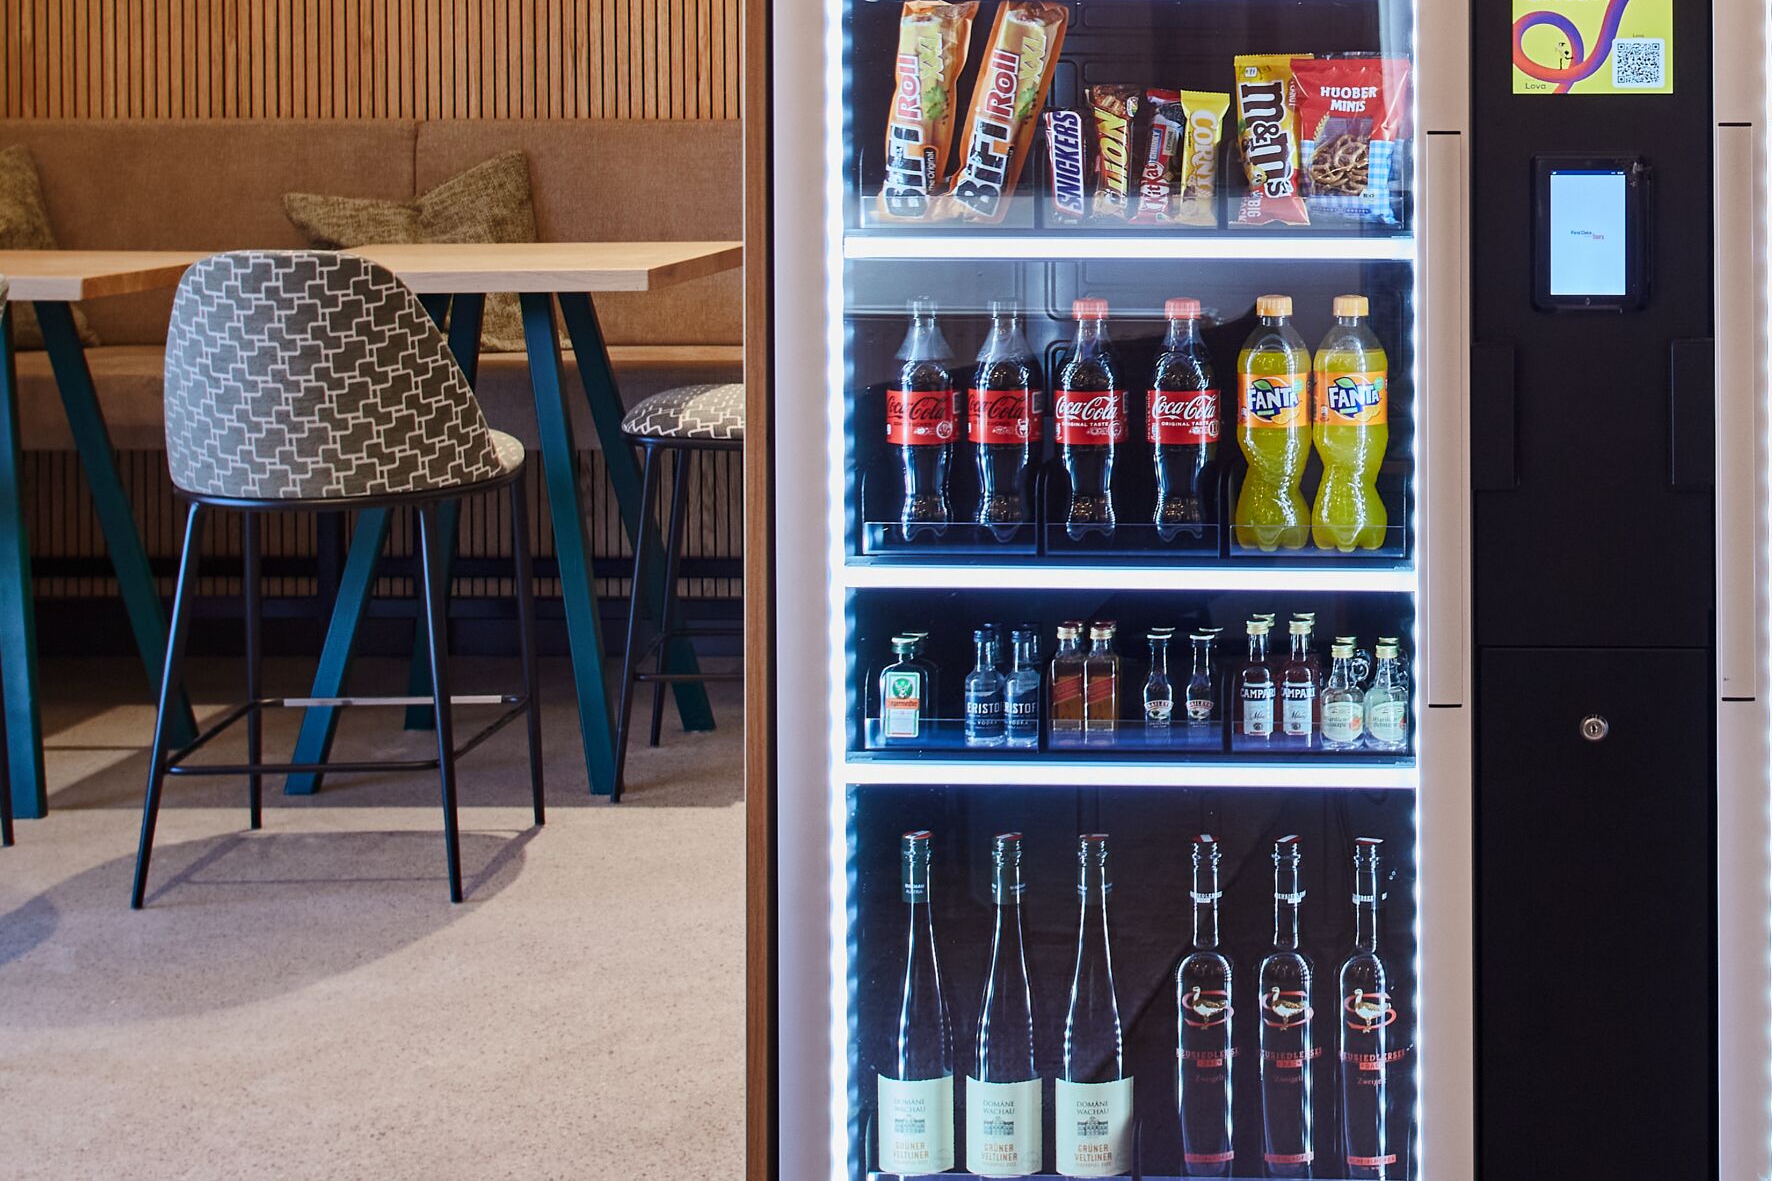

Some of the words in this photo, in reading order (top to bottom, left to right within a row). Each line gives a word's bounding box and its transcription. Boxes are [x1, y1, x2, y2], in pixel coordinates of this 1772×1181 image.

[896, 54, 923, 121] Roll
[985, 50, 1021, 119] Roll
[1320, 86, 1377, 99] HUOBER
[1525, 82, 1546, 90] Lova
[1330, 99, 1366, 112] MINIS
[1149, 129, 1161, 161] CHUNKY
[928, 151, 936, 181] Original
[1052, 110, 1083, 211] SNICKERS
[888, 395, 946, 420] Coca-Cola
[1055, 395, 1119, 420] Coca-Cola
[1152, 395, 1217, 420] Coca-Cola
[1247, 387, 1298, 410] FANTA
[1328, 384, 1379, 409] FANTA
[983, 1107, 1016, 1115] WACHAU
[980, 1152, 1018, 1161] VELTLINER
[1074, 1152, 1113, 1161] VELTLINER
